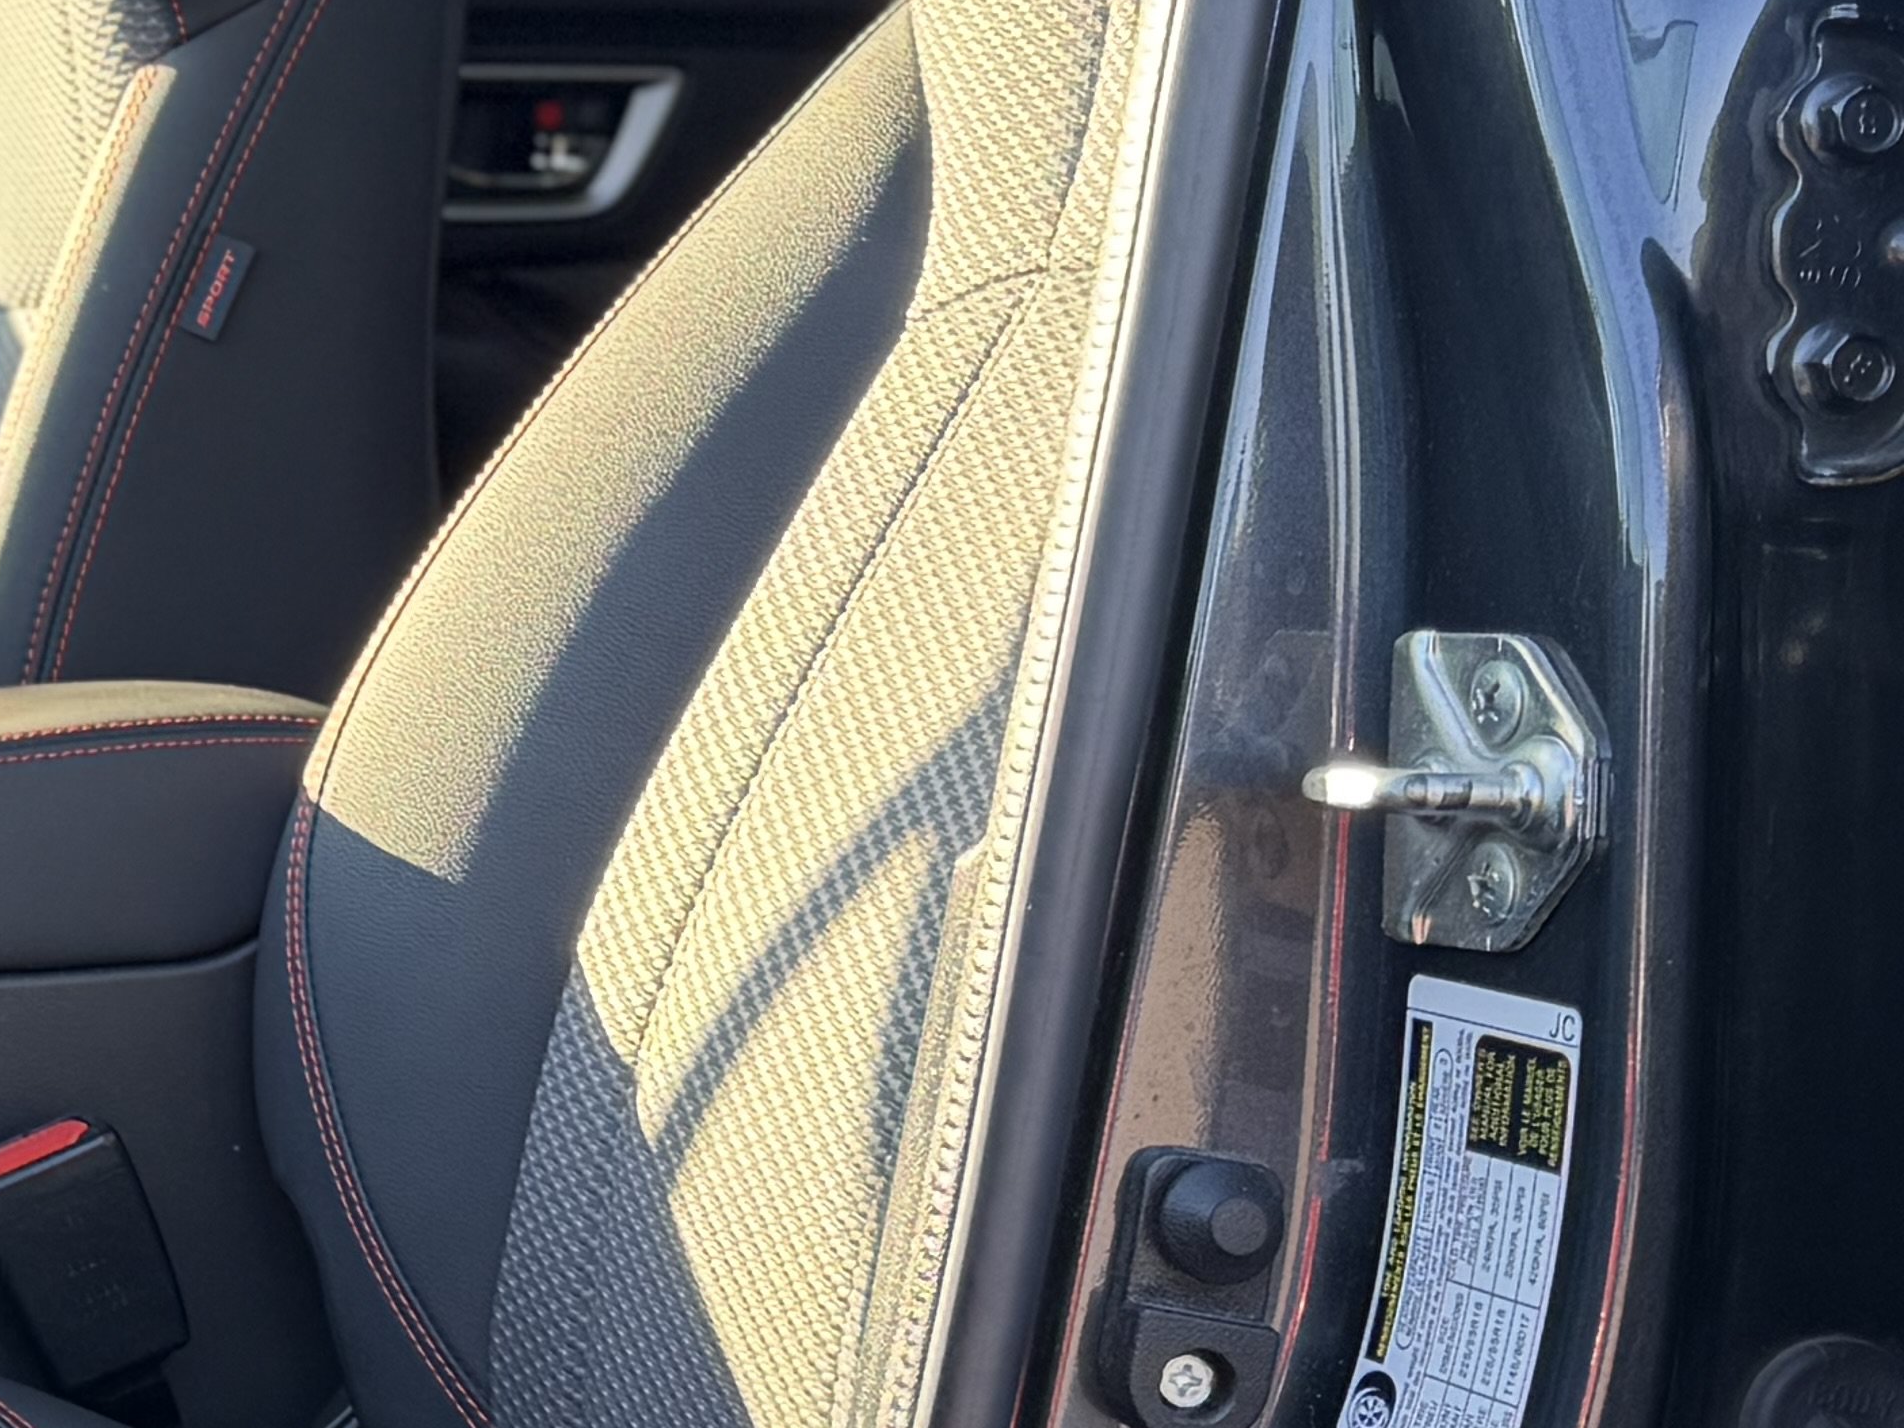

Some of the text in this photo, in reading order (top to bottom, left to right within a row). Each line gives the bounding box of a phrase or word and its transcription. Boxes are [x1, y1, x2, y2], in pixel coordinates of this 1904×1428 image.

[196, 249, 236, 329] SPORT
[1548, 1011, 1577, 1043] JC
[1478, 1086, 1492, 1140] MANUAL
[1498, 1054, 1515, 1146] INFORMATION
